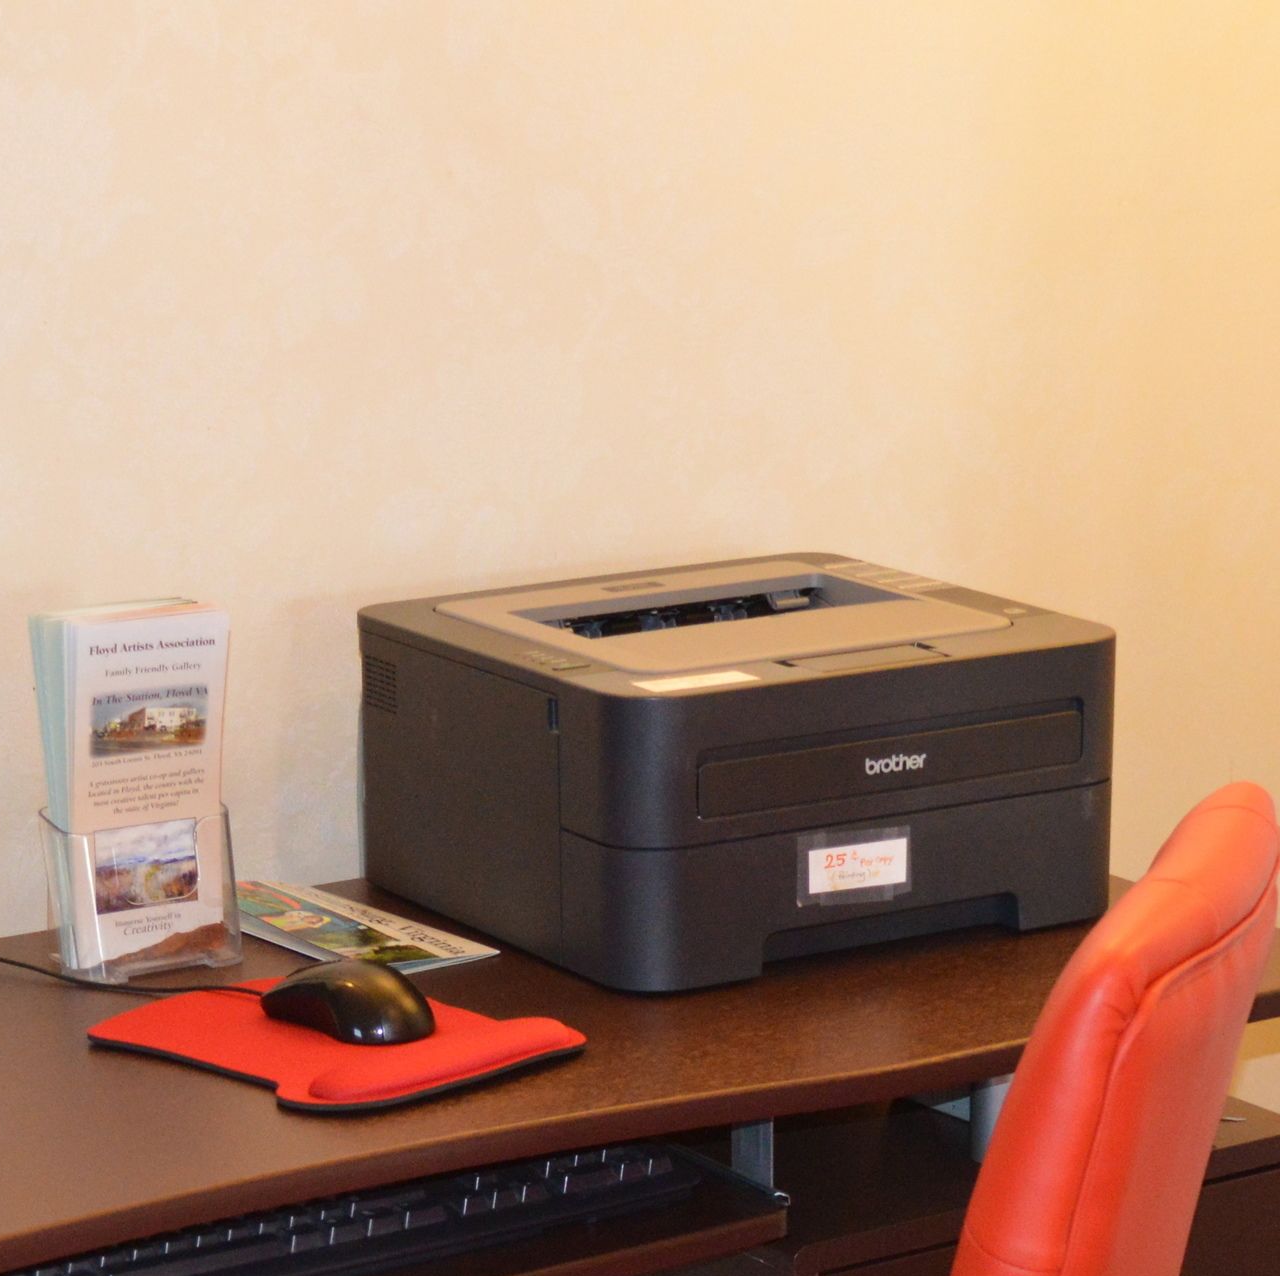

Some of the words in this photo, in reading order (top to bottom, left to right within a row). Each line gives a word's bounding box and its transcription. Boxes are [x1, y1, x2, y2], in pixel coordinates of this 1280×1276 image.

[89, 643, 118, 657] Floyd
[121, 641, 154, 653] Artists
[157, 636, 216, 649] Association
[865, 753, 926, 776] brother
